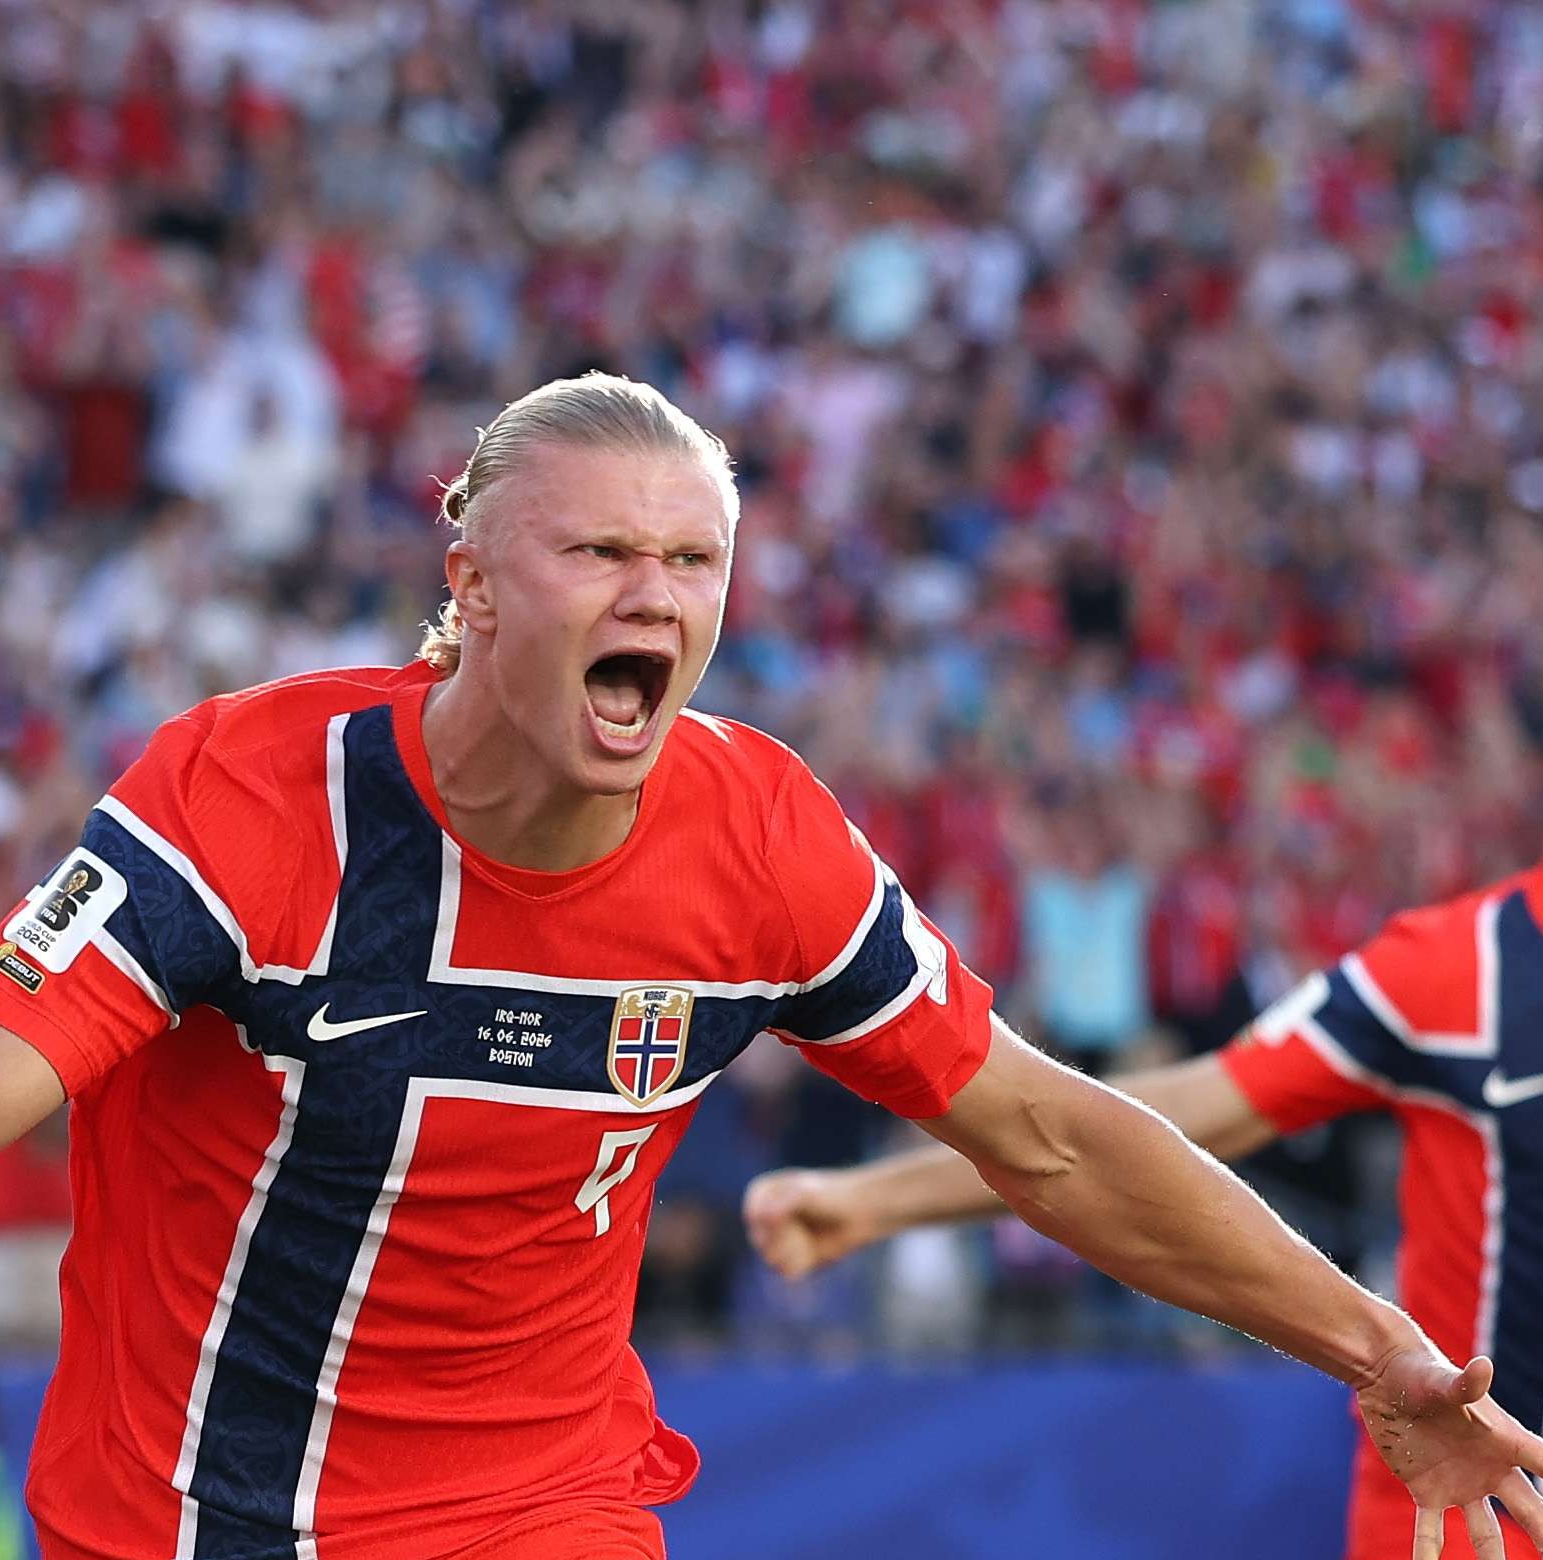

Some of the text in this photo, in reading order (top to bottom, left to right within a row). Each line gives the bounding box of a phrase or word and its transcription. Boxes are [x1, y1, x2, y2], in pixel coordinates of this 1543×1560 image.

[17, 926, 51, 953] 2026
[41, 929, 57, 943] CUP
[4, 956, 40, 982] DEBUT
[495, 1009, 543, 1027] IRQ-NOR
[521, 1031, 553, 1048] 2026
[489, 1048, 534, 1068] BOSTON
[574, 1122, 659, 1238] 9
